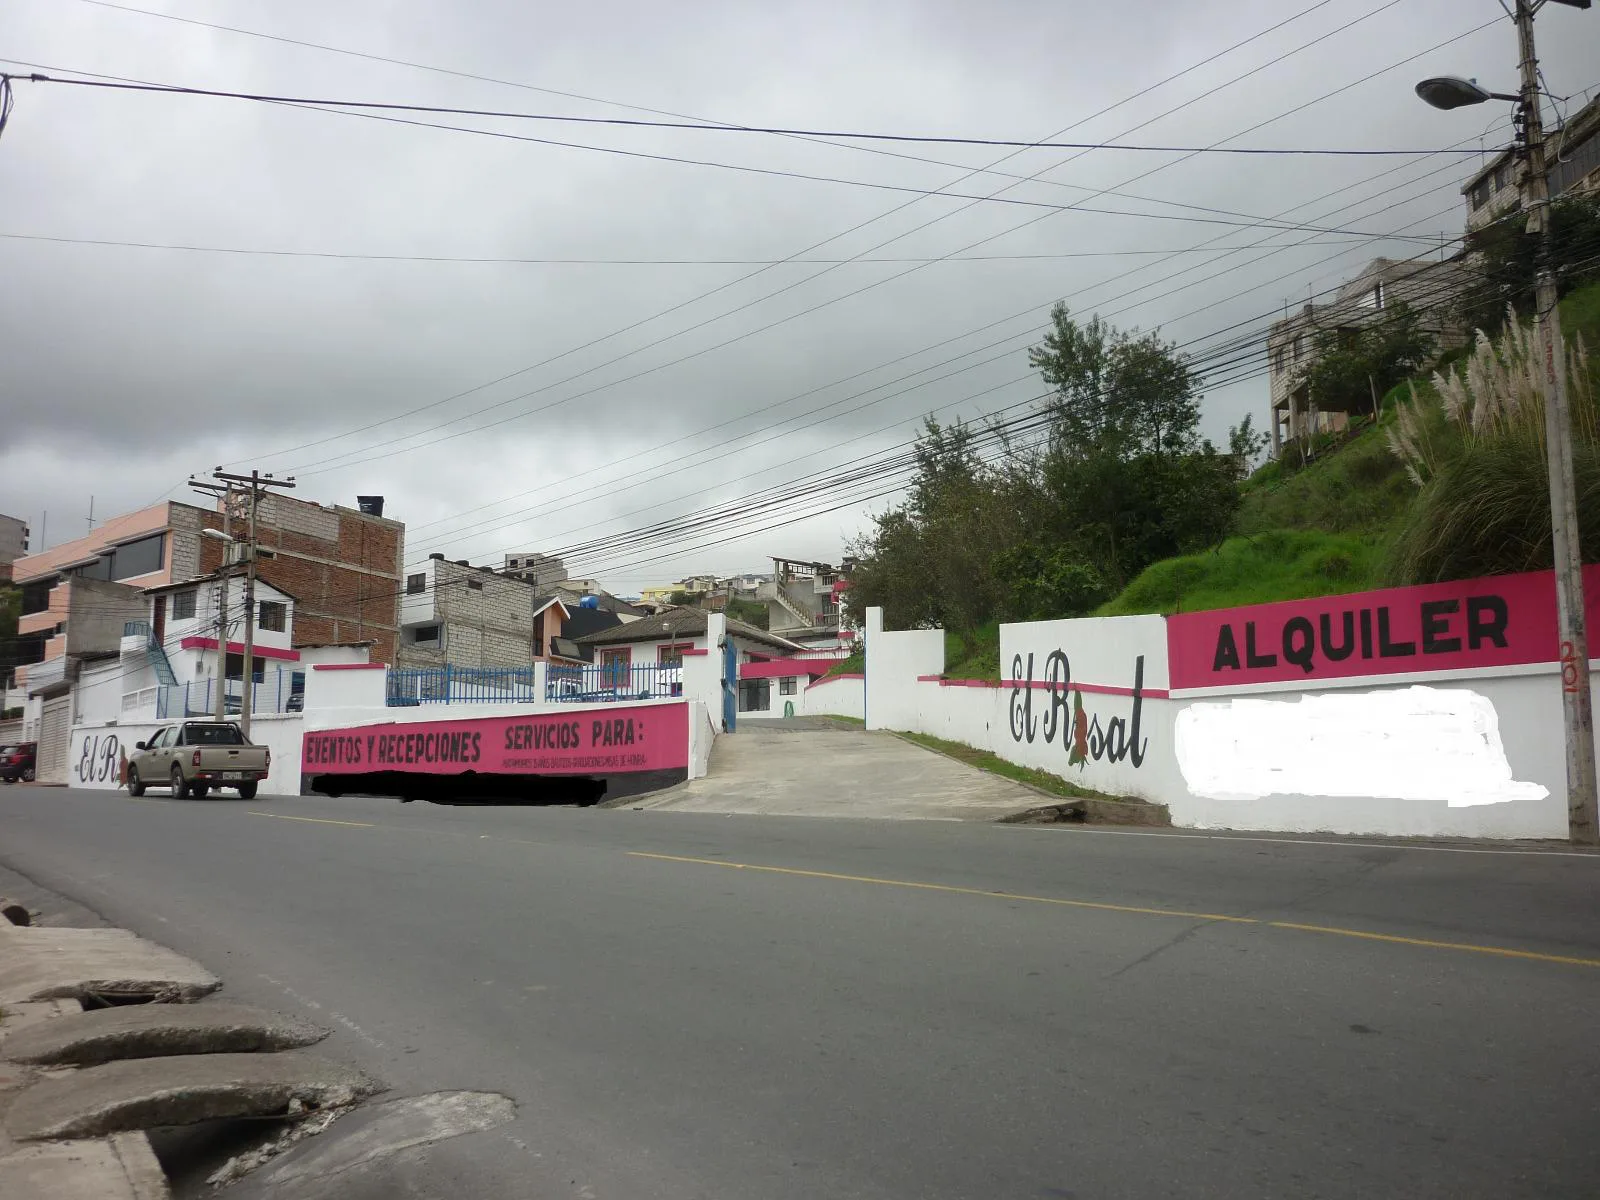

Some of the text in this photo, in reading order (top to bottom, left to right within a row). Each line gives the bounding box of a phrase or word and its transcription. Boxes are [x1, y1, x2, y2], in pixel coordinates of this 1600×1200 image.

[1213, 595, 1509, 673] ALQUILER
[1010, 648, 1148, 769] El Rsal
[306, 737, 361, 764] EVENTOS
[367, 735, 375, 763] Y
[378, 732, 482, 763] RECEPCIONES
[504, 718, 644, 750] SERVICIOS PARA:
[80, 736, 98, 783] El
